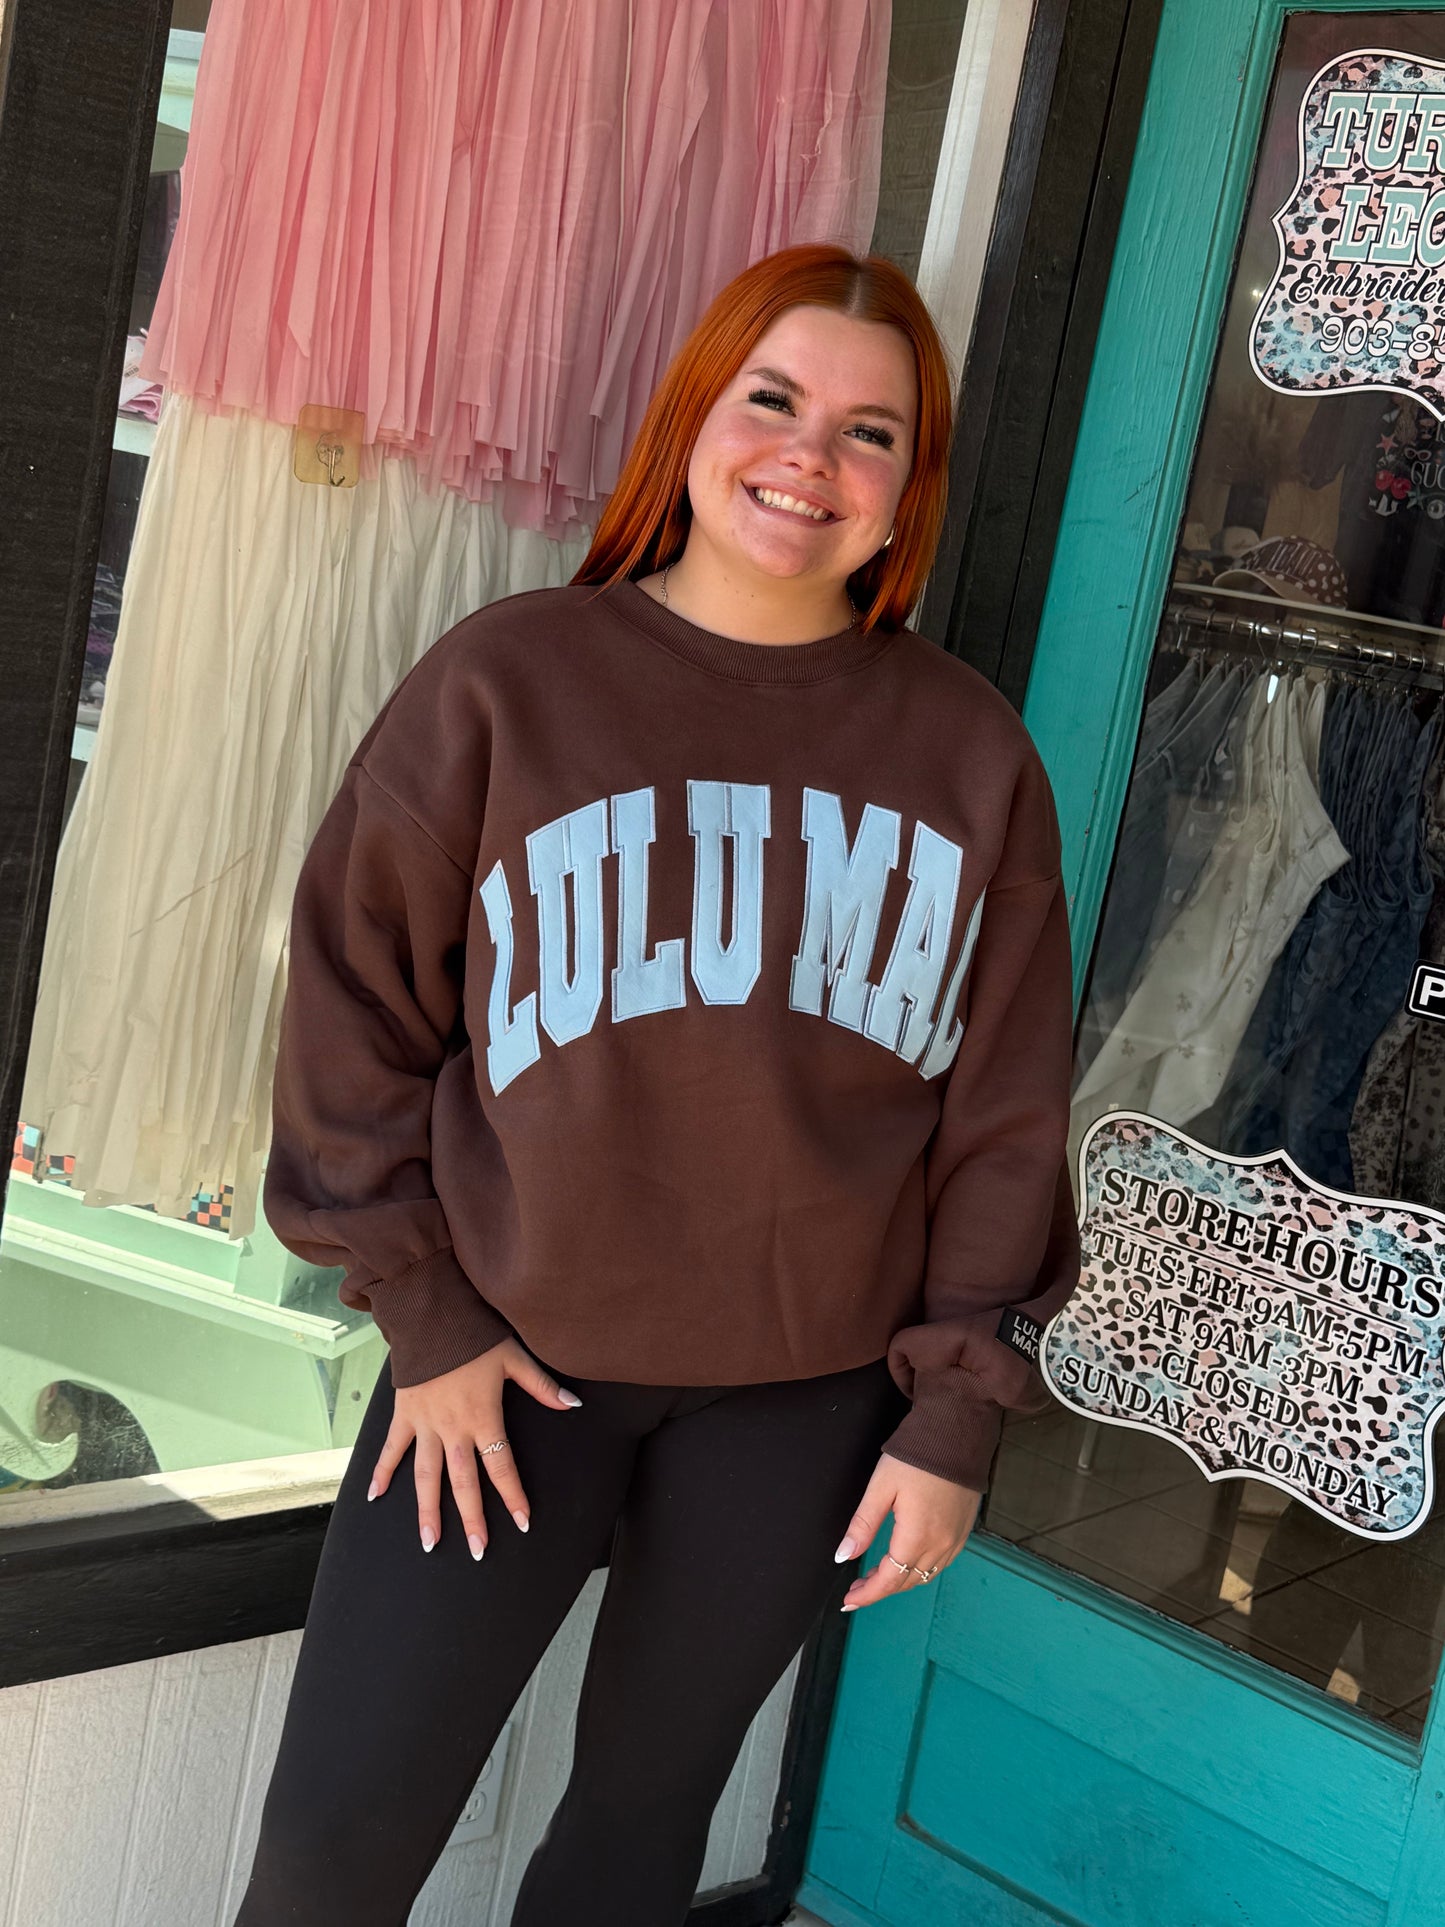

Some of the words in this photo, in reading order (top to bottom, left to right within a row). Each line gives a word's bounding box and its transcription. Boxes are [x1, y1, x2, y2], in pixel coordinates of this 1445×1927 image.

[1321, 91, 1445, 173] TUR
[1289, 263, 1445, 305] Embroider
[479, 780, 771, 1096] LULU
[1092, 1229, 1249, 1311] TUES-FRI
[1252, 1296, 1427, 1379] 9AM-5PM
[1100, 1168, 1255, 1254] STORE
[1261, 1222, 1444, 1318] HOURS
[1126, 1289, 1190, 1336] SAT
[1194, 1323, 1362, 1405] 9AM-3PM
[1162, 1351, 1300, 1427] CLOSED
[1062, 1356, 1196, 1431] SUNDAY
[1199, 1415, 1226, 1447] &
[1234, 1429, 1397, 1517] MONDAY
